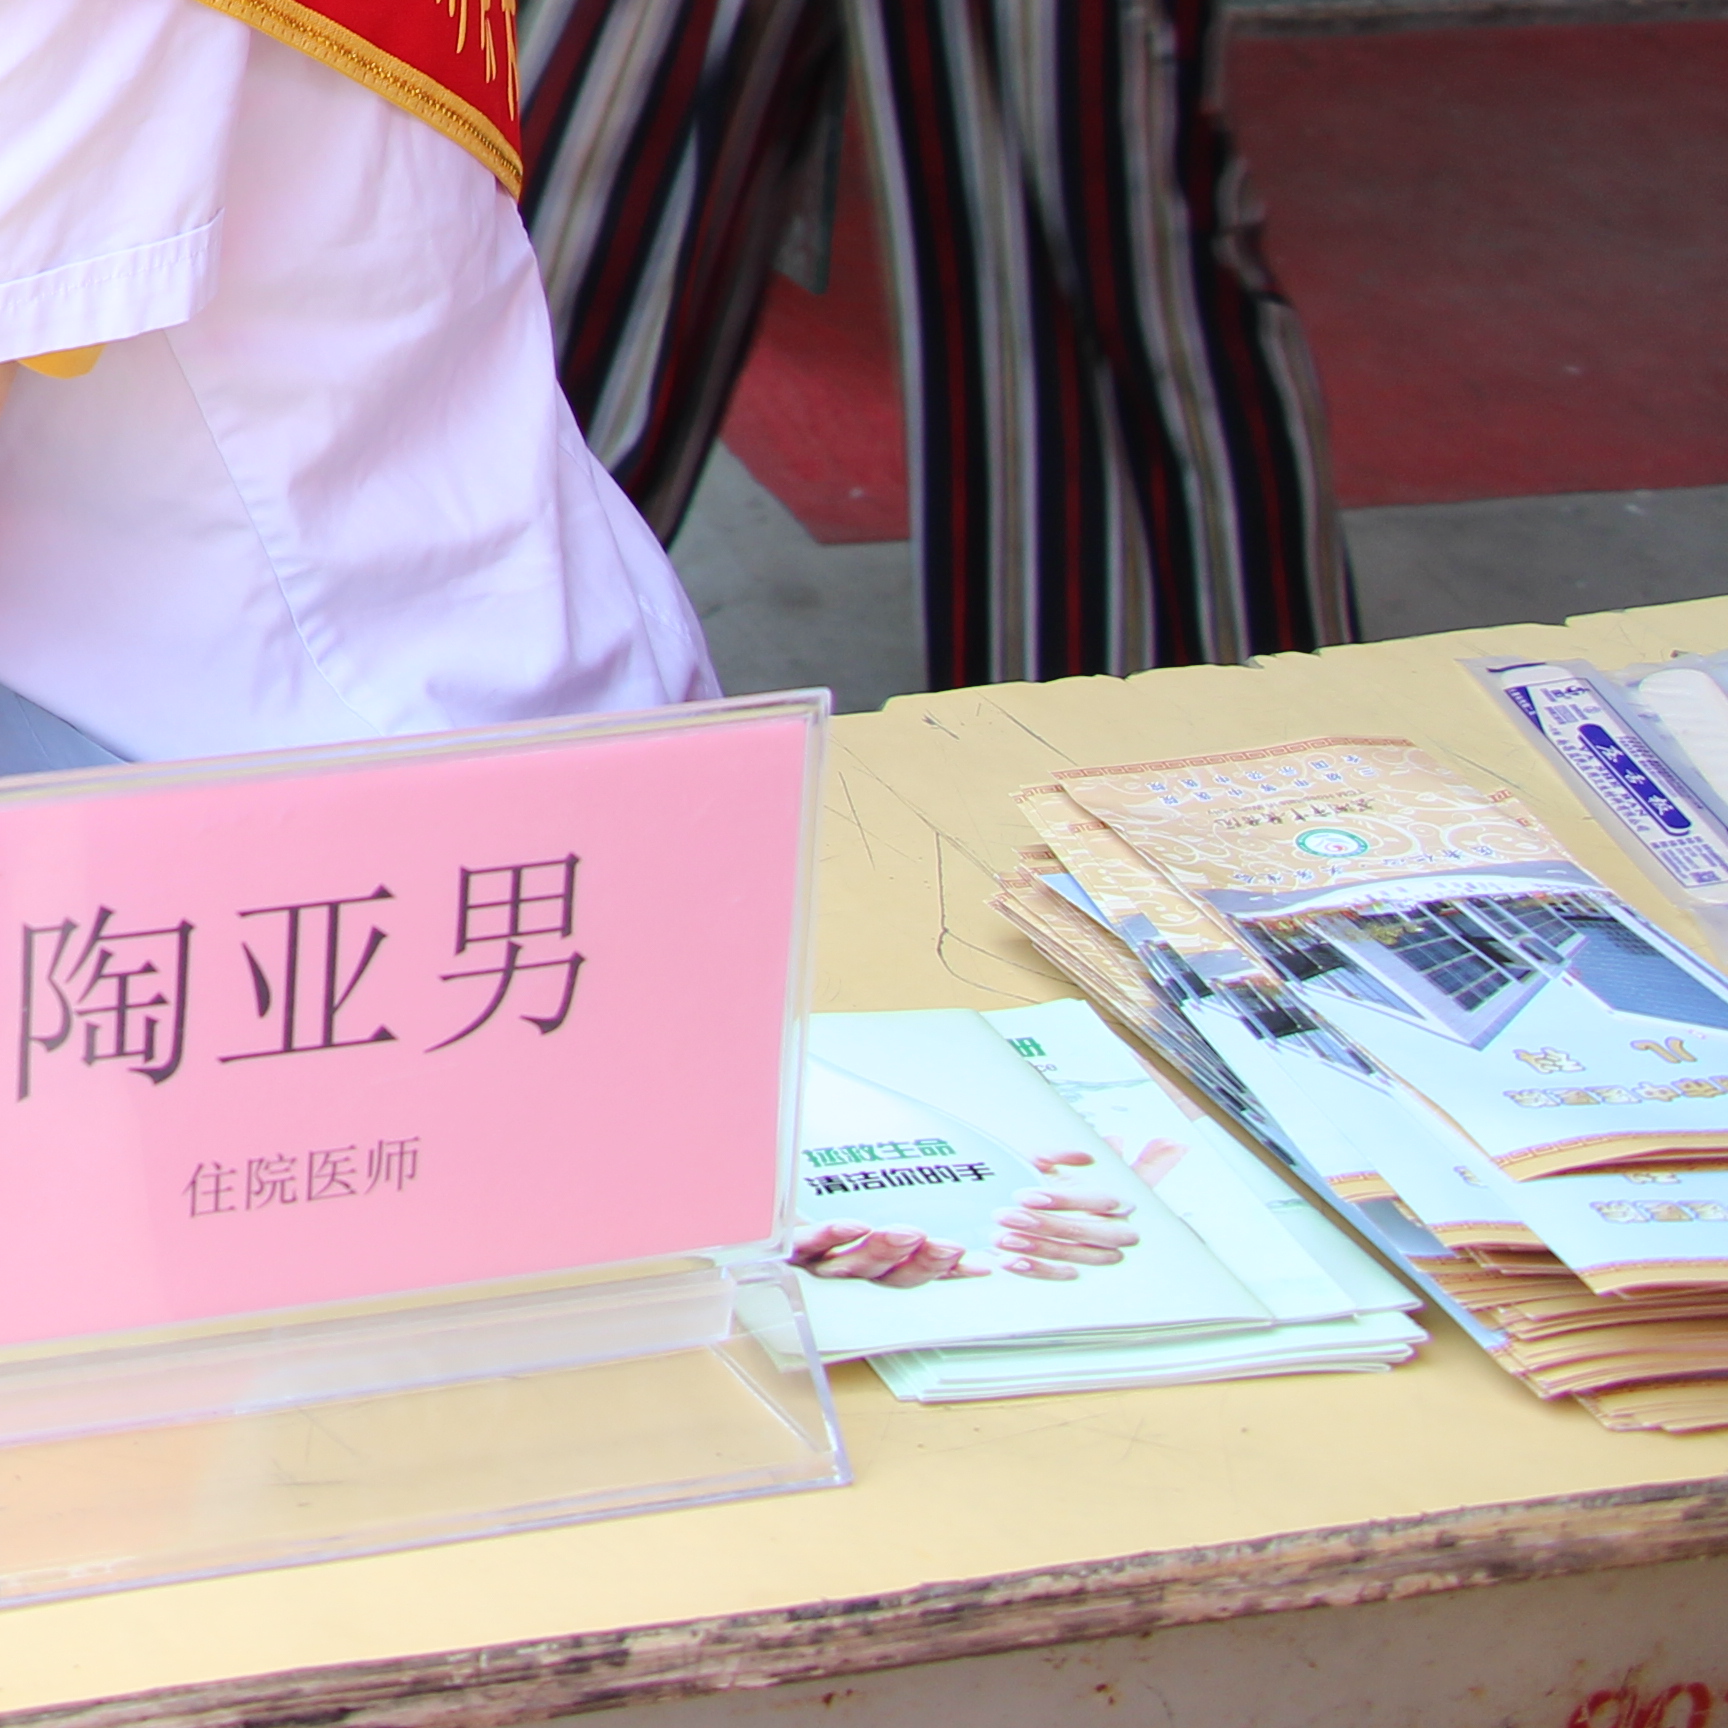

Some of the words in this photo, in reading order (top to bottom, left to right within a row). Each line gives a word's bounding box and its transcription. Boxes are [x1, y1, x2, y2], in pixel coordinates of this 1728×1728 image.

[14, 850, 590, 1103] 陶亚男
[179, 1134, 424, 1219] 住院医师
[801, 1137, 957, 1169] 拯救生命
[803, 1161, 997, 1197] 清洁你的手
